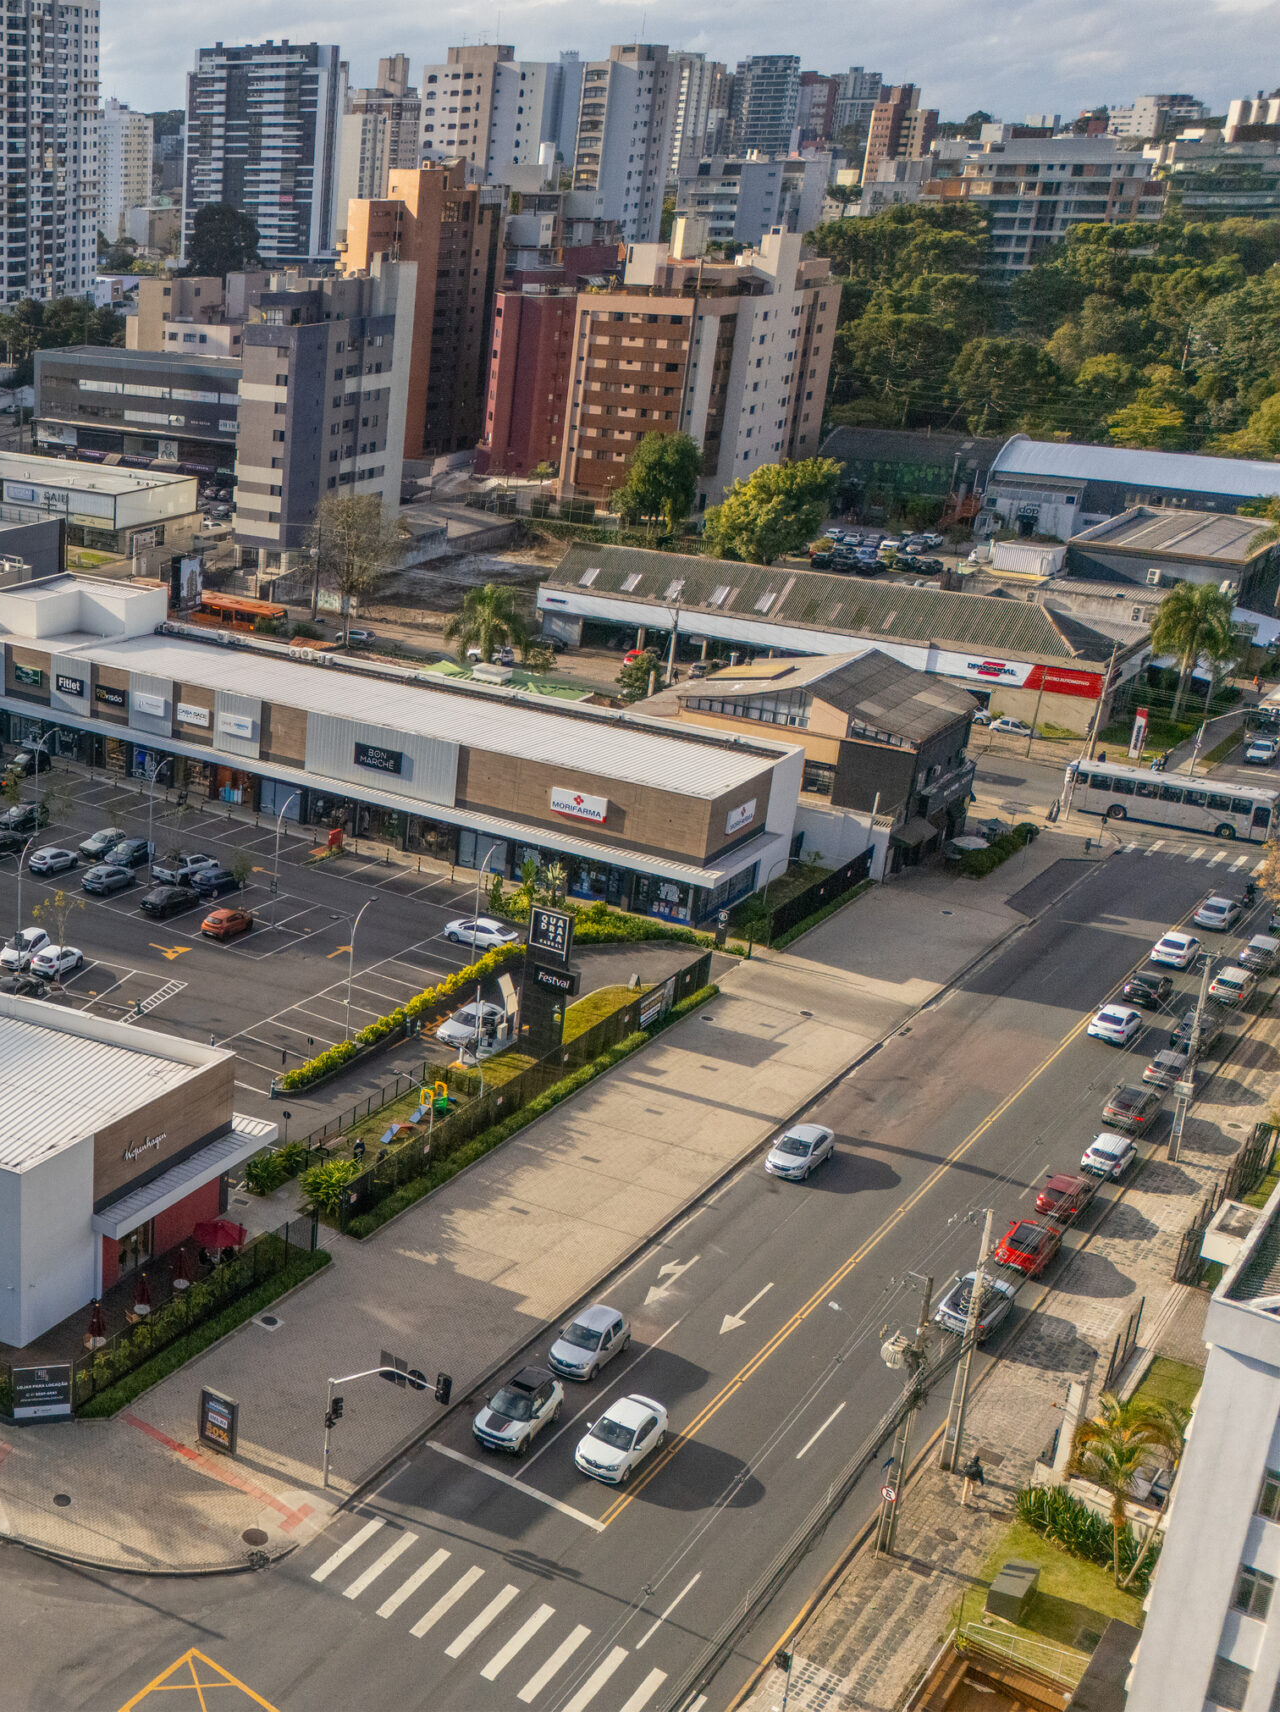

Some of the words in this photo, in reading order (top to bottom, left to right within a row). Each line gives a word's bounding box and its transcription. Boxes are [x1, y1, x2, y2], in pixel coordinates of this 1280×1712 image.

[58, 676, 80, 691] Fitlet
[368, 748, 387, 759] BON
[552, 800, 602, 818] MORIFARMA
[541, 914, 564, 928] QUA
[548, 932, 562, 943] TA
[538, 971, 570, 989] Festval
[123, 1132, 167, 1161] Kopenhagen
